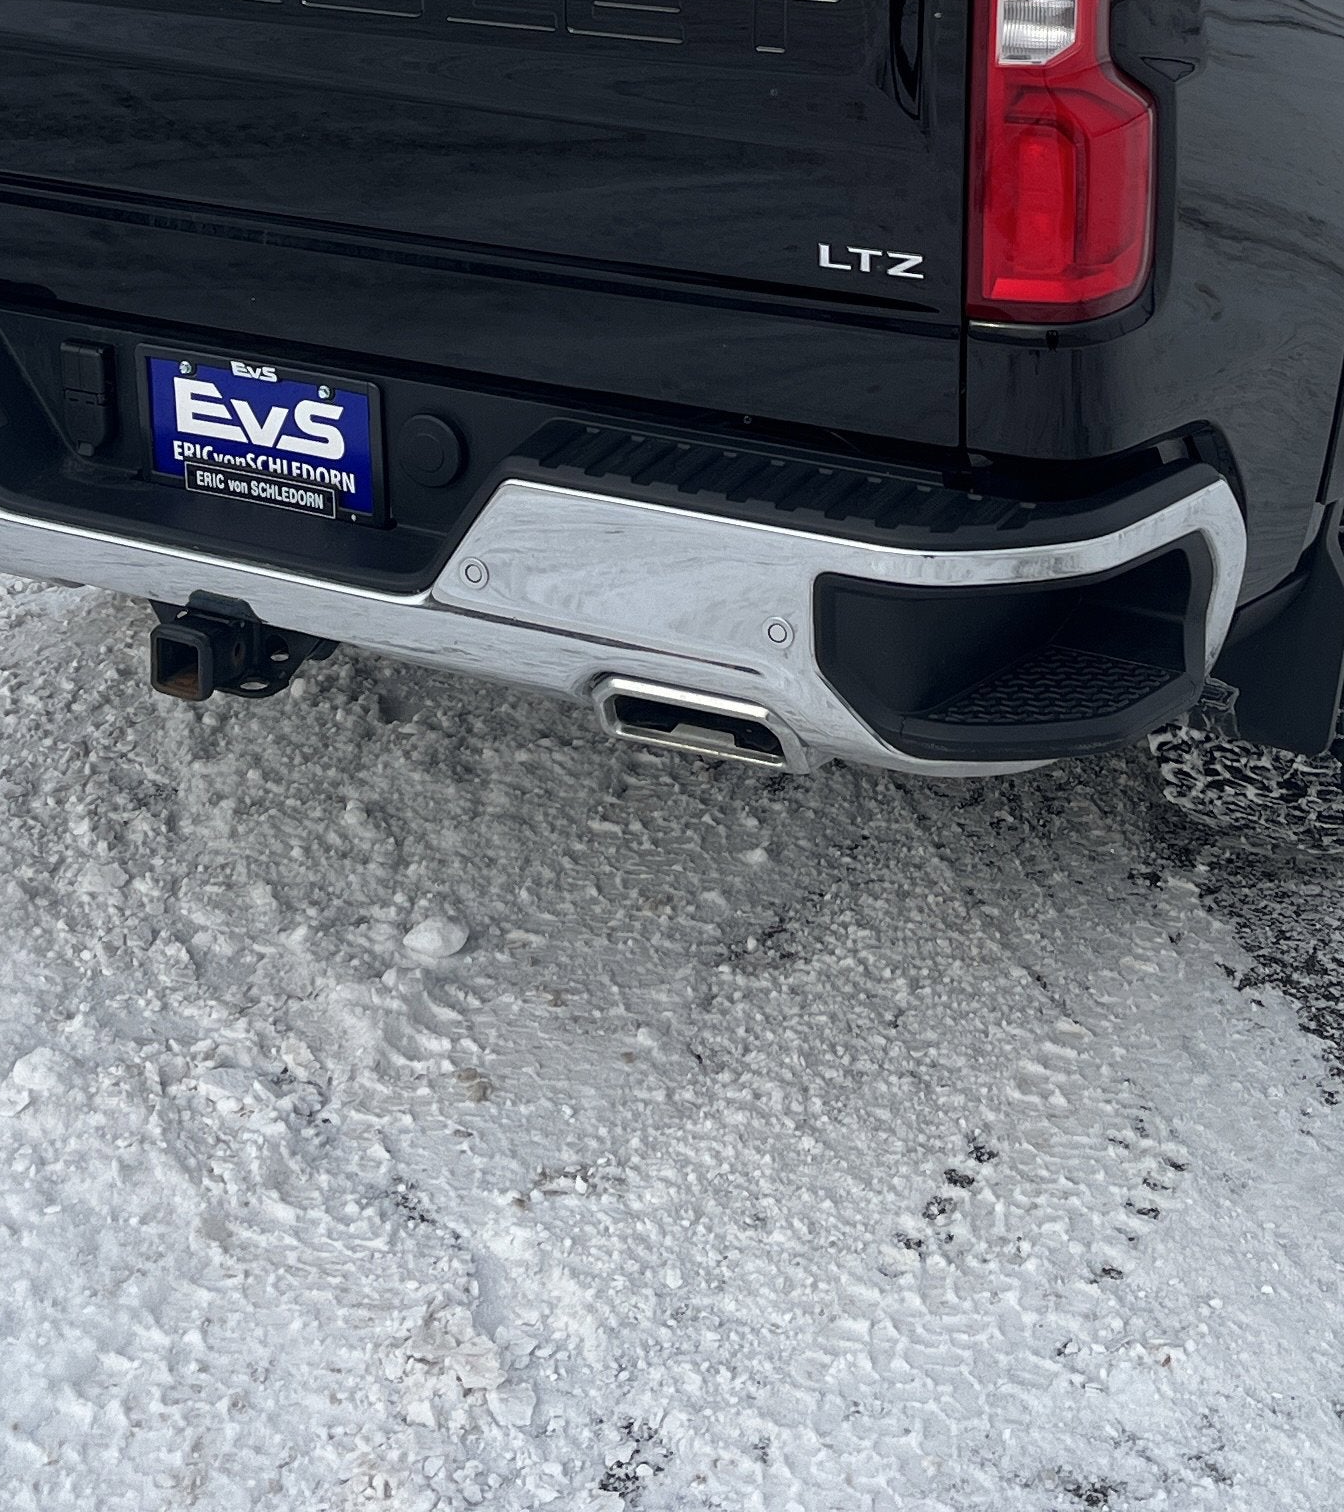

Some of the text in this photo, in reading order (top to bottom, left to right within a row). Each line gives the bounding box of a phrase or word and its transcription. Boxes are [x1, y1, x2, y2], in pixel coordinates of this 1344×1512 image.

[818, 243, 924, 279] LTZ
[196, 470, 324, 509] ERIC von SCHLEDORN
